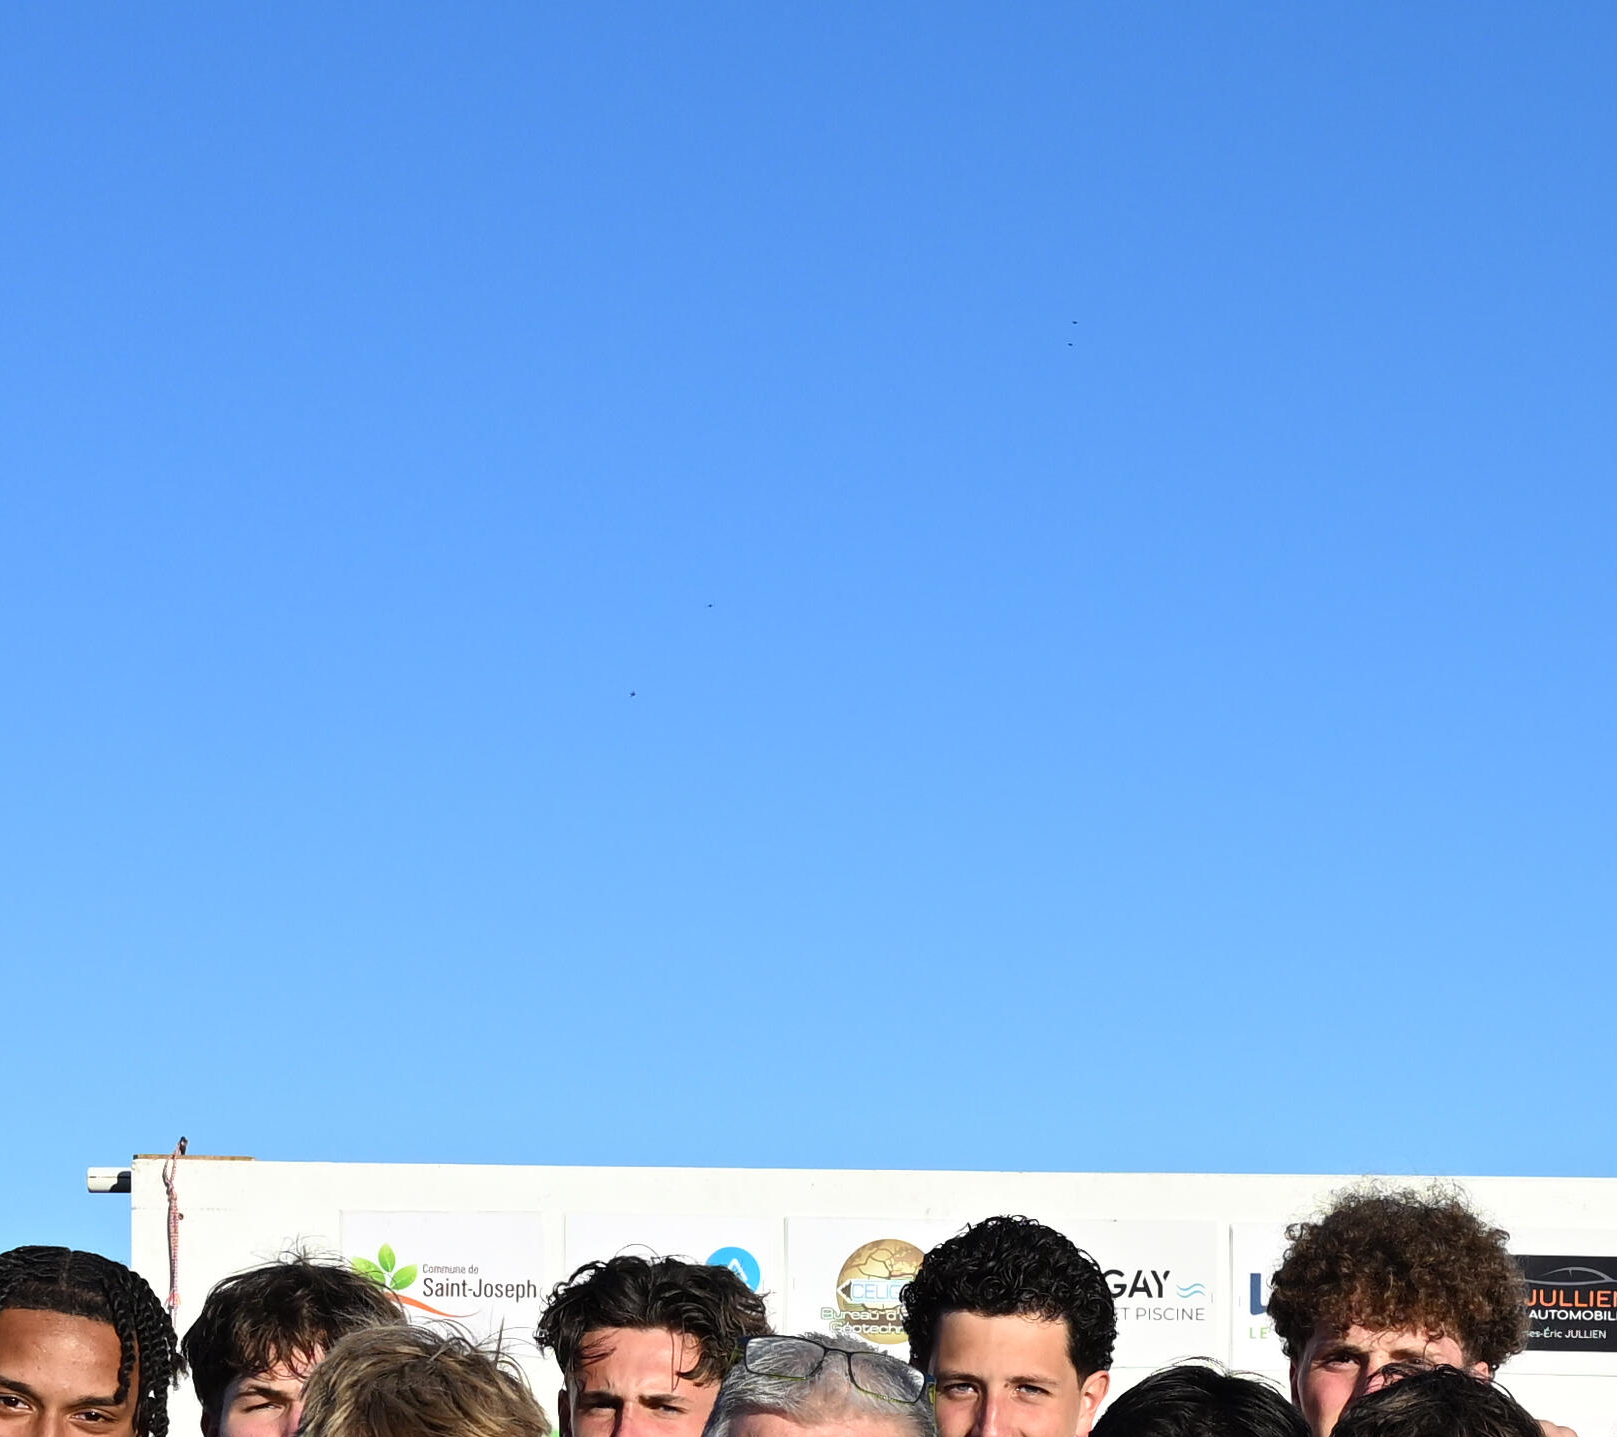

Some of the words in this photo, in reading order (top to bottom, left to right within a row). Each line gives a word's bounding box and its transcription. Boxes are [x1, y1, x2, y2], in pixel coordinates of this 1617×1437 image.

[422, 1264, 466, 1275] Commune
[422, 1277, 537, 1304] Saint-Joseph
[821, 1307, 880, 1321] Bureau
[1135, 1307, 1206, 1321] PISCINE
[829, 1321, 905, 1335] Géotechn
[1564, 1329, 1607, 1339] JULLIEN
